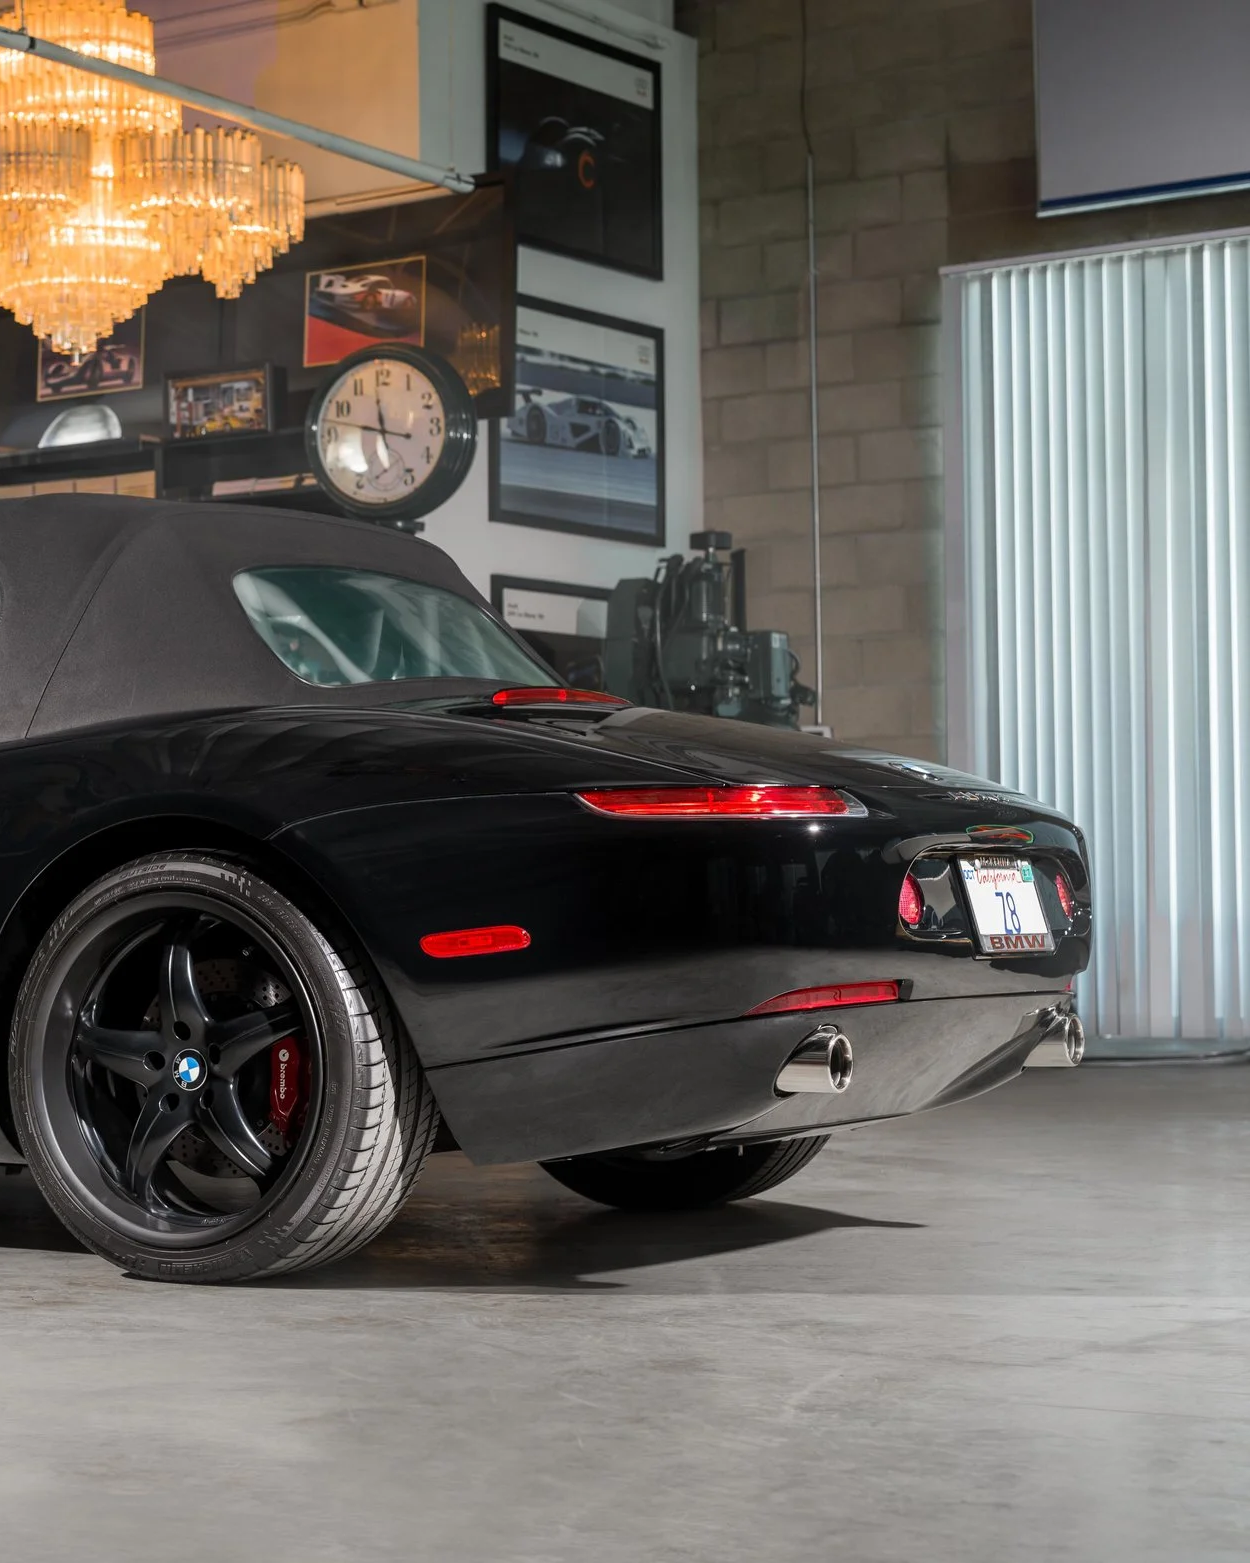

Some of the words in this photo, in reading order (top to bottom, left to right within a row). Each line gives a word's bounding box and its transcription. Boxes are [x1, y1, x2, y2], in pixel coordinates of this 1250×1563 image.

[354, 378, 363, 396] 11
[375, 369, 391, 387] 12
[336, 401, 350, 418] 10
[421, 392, 433, 409] 2
[430, 417, 441, 436] 3
[404, 467, 414, 487] 5
[994, 891, 1021, 935] Z8
[989, 935, 1045, 950] BMW
[279, 1062, 288, 1100] brembo
